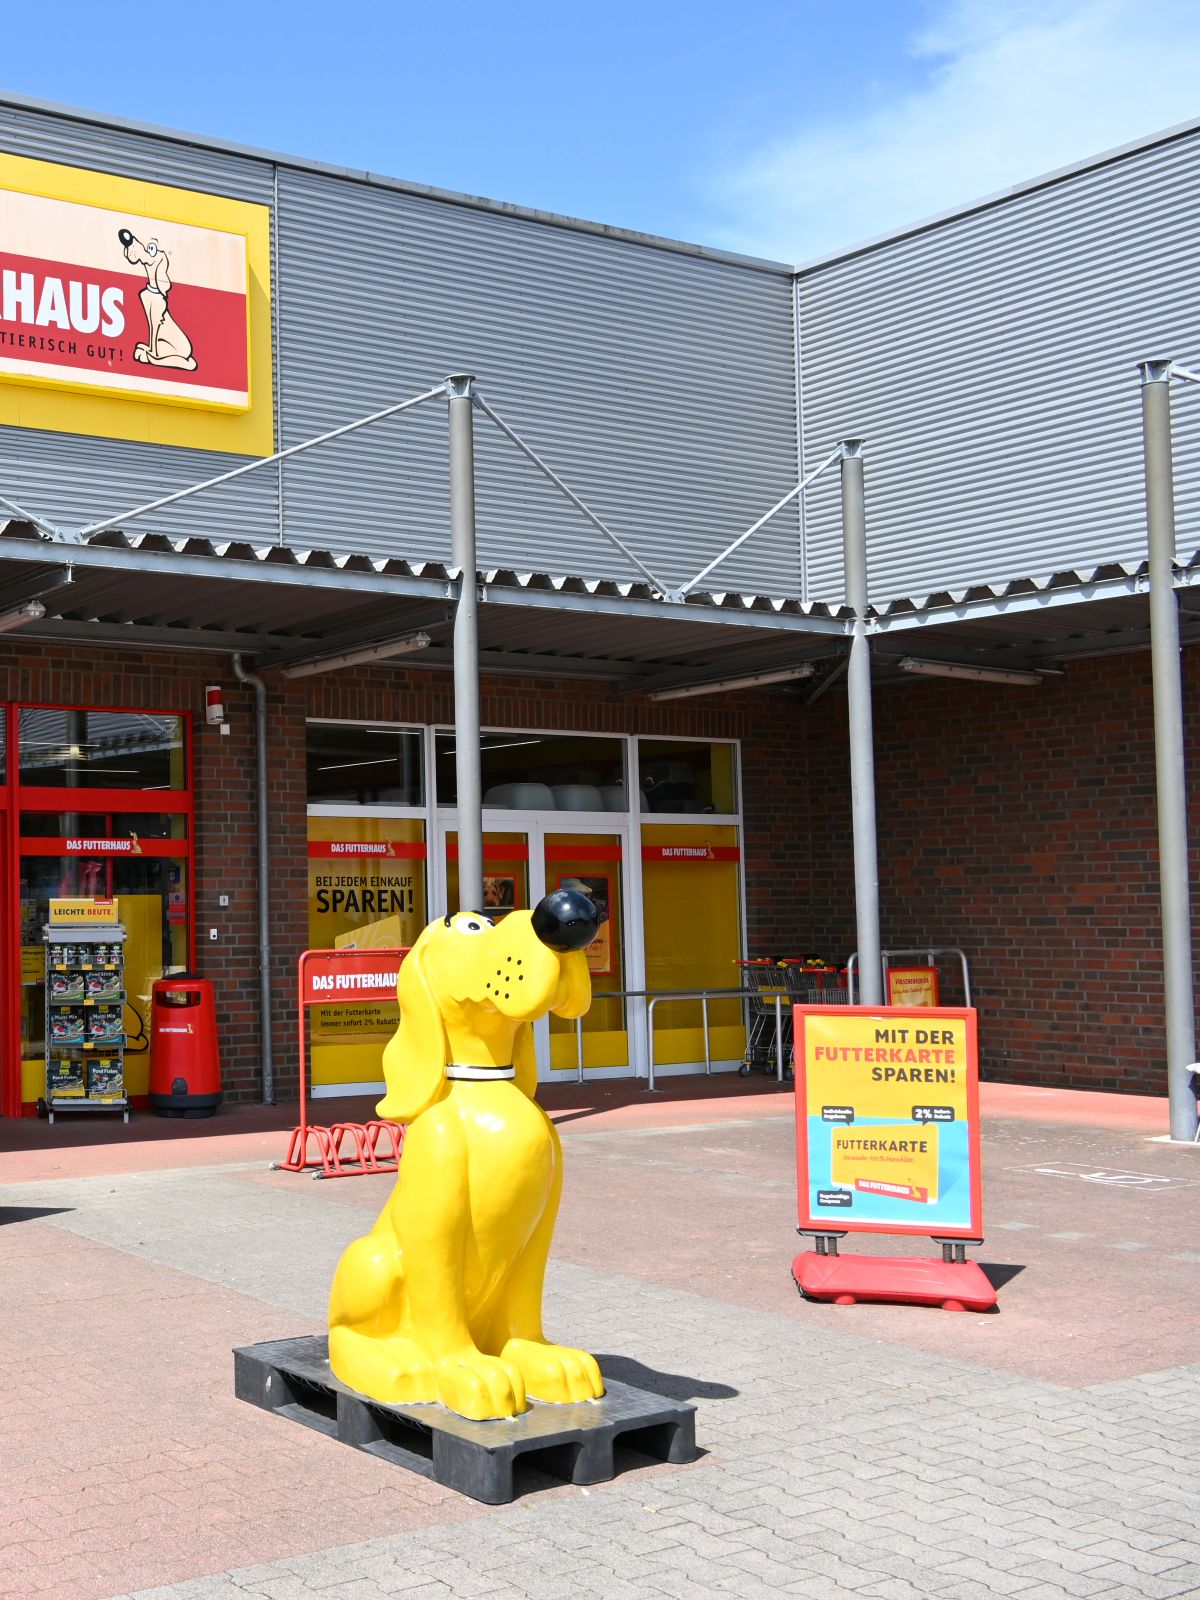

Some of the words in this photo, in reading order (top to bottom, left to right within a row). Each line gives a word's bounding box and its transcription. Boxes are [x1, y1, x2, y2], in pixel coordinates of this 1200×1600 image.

[0, 331, 79, 356] TIERISCH
[86, 342, 124, 362] GUT!
[66, 840, 82, 850] DAS
[83, 841, 131, 850] FUTTERHAUS
[331, 844, 344, 853] DAS
[345, 844, 386, 852] FUTTERHAUS
[662, 848, 673, 856] DAS
[674, 848, 707, 857] FUTTERHAUS
[316, 876, 333, 887] BEI
[334, 876, 367, 887] JEDEM
[370, 877, 413, 887] EINKAUF
[316, 889, 414, 913] SPAREN!
[312, 975, 334, 990] DAS
[335, 972, 399, 989] FUTTERHAU
[320, 1009, 331, 1017] Mit
[345, 1008, 381, 1016] Futterkarte
[320, 1020, 341, 1028] immer
[875, 1029, 909, 1044] MIT
[915, 1030, 955, 1045] DER
[815, 1046, 956, 1064] FUTTERKARTE
[871, 1067, 956, 1083] SPAREN!
[915, 1109, 933, 1118] 2%
[836, 1140, 928, 1153] FUTTERKARTE
[858, 1180, 870, 1188] DAS
[870, 1182, 910, 1195] FUTTERHAUS
